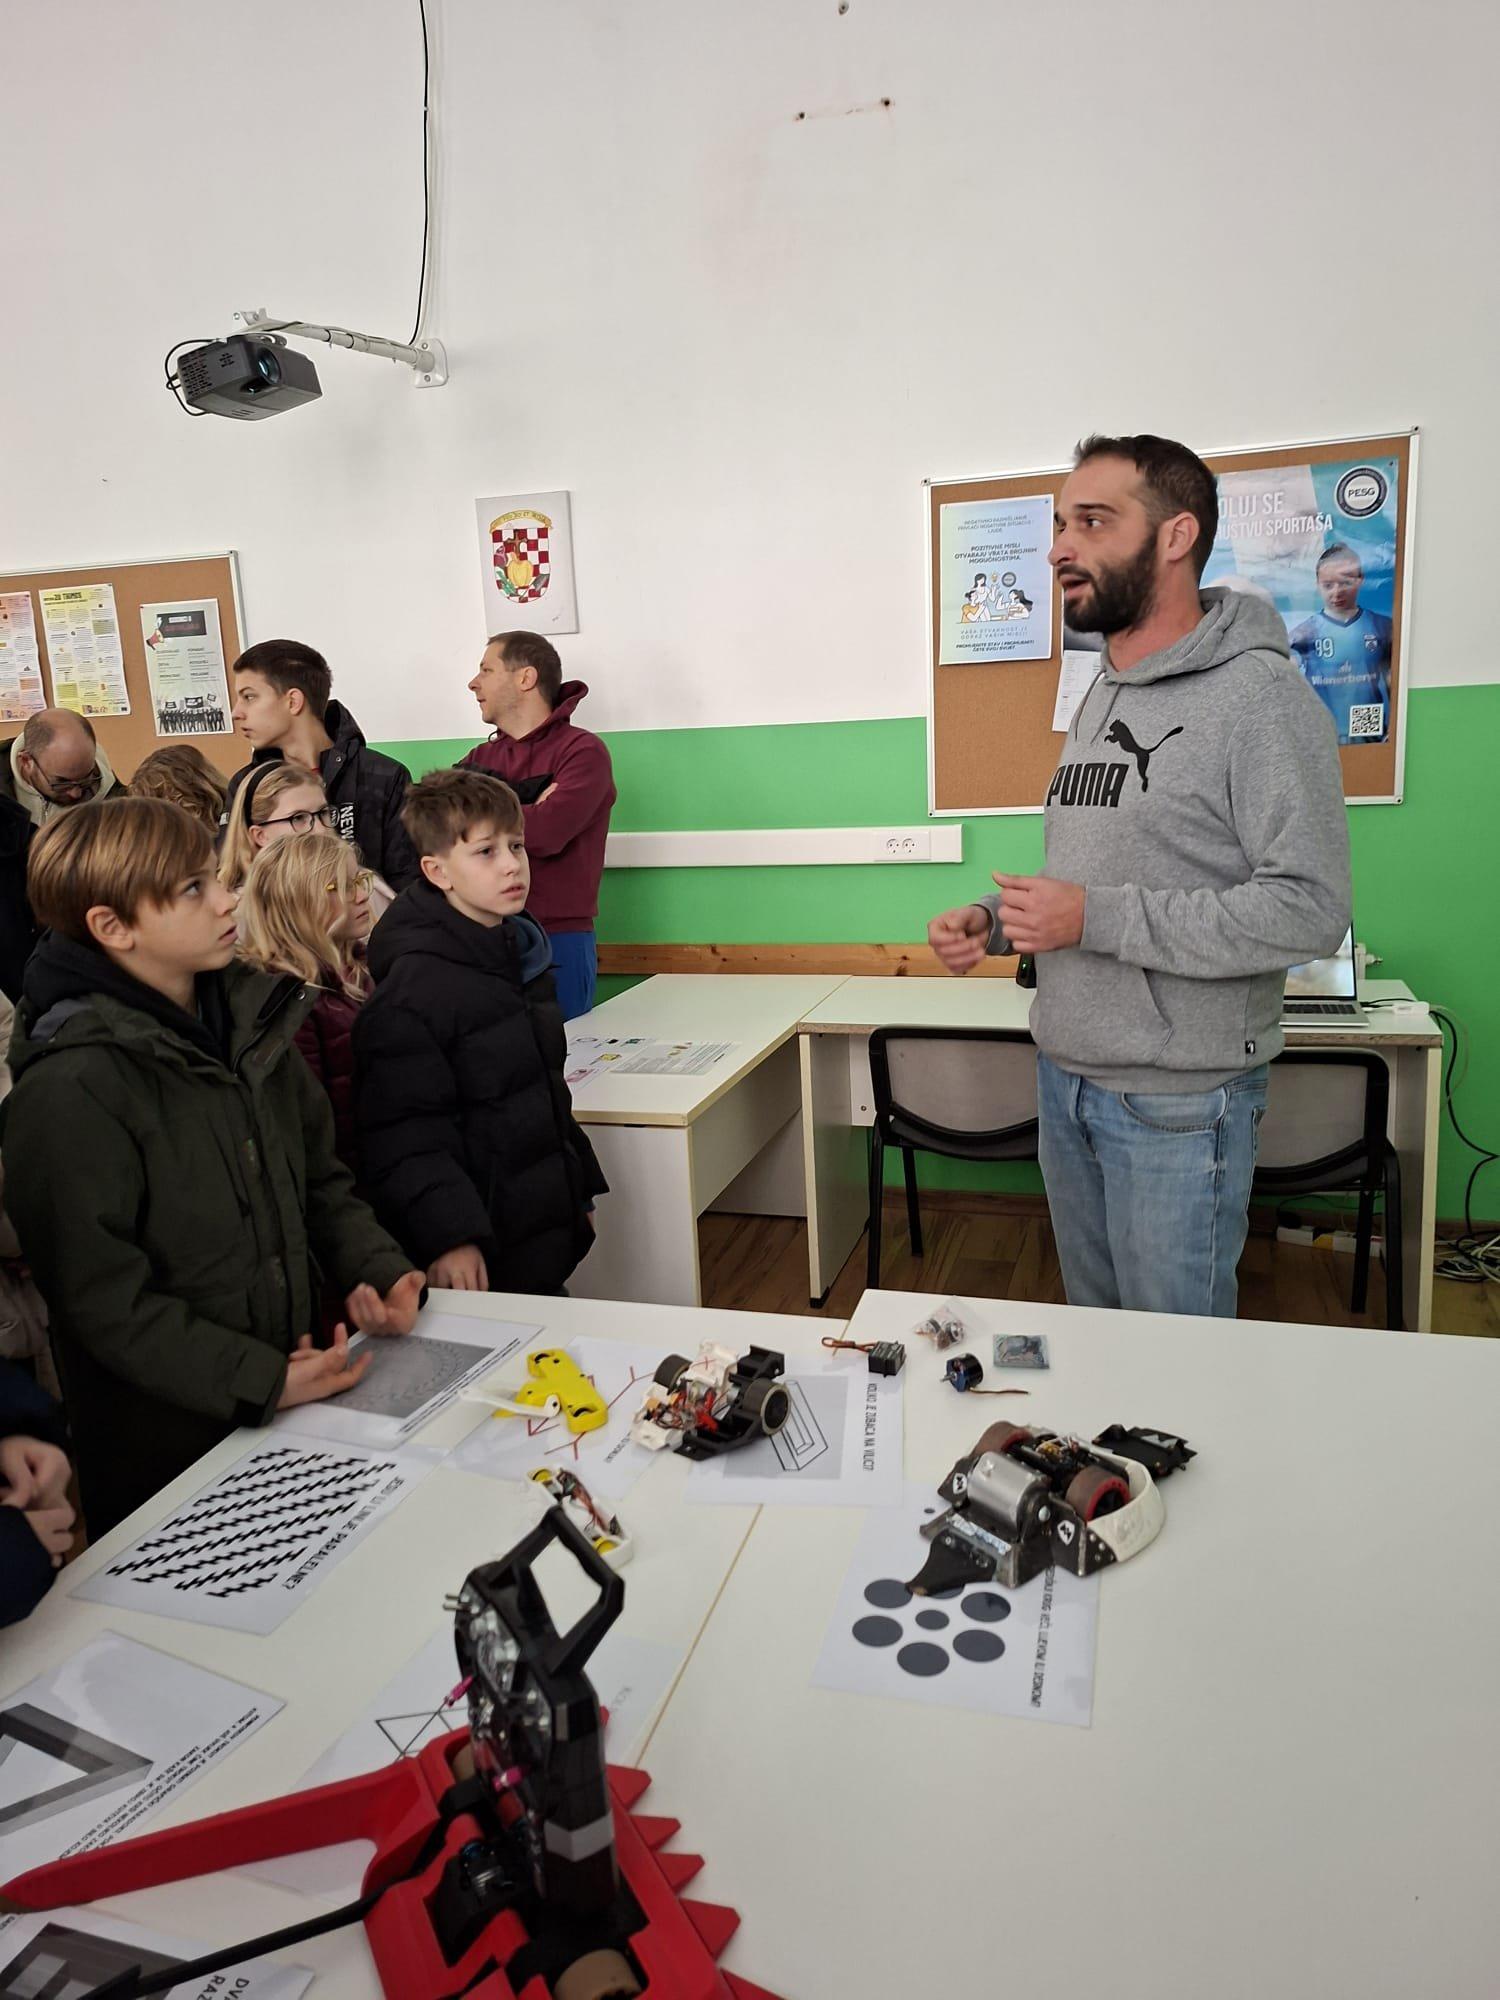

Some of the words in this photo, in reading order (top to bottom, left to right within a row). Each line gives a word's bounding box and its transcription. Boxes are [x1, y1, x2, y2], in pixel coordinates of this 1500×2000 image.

[1348, 487, 1376, 498] PESG
[1218, 494, 1256, 518] OLUJ
[1262, 491, 1285, 514] SE
[1266, 511, 1333, 536] SPORTAŠA
[954, 551, 987, 559] OTVARAJU
[971, 543, 1003, 552] POZITIVNE
[1046, 763, 1129, 807] PUMA
[340, 805, 354, 839] NEW
[864, 1437, 874, 1446] NA
[224, 1978, 249, 2000] DV
